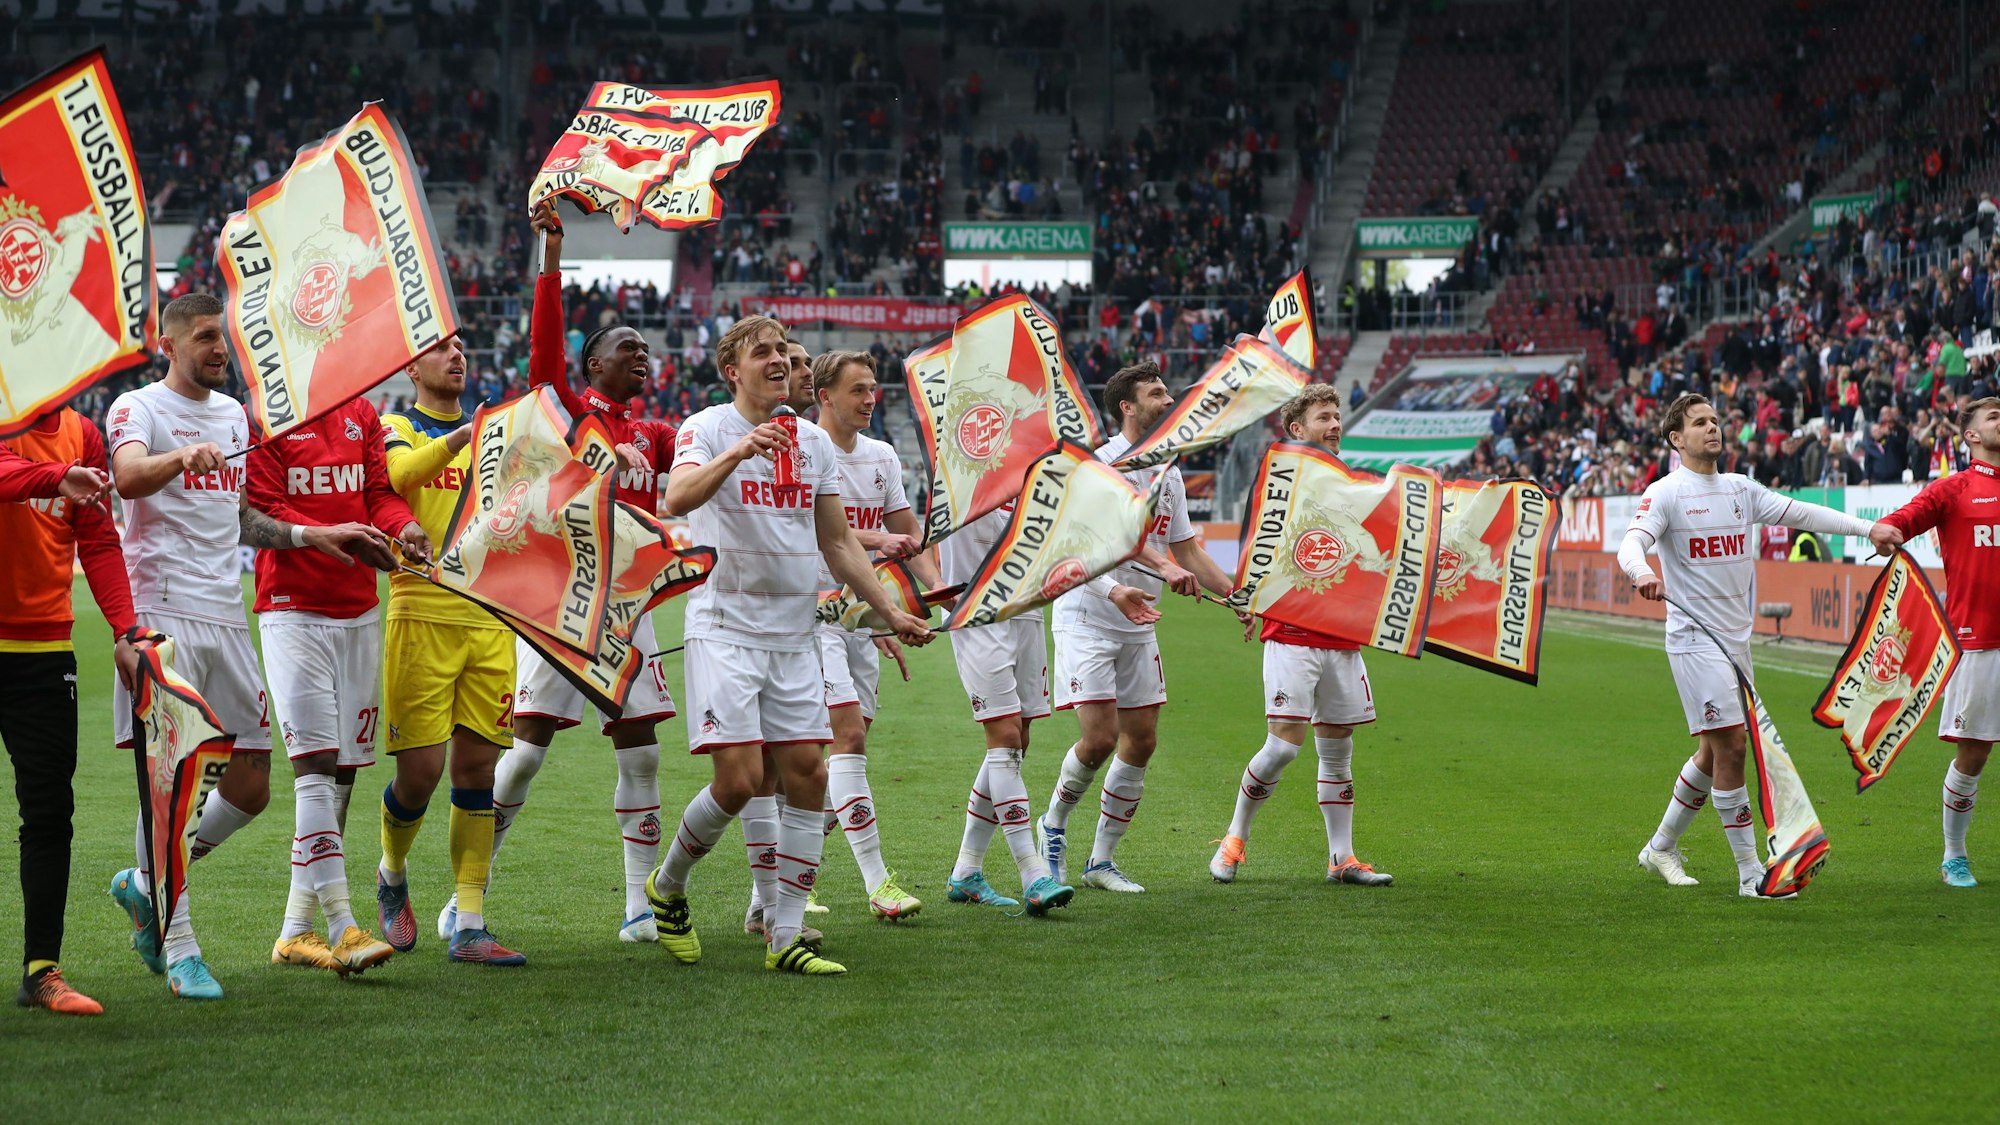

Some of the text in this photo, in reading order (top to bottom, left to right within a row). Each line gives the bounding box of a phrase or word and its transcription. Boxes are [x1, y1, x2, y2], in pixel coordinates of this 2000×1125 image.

[589, 396, 611, 412] REWE
[171, 428, 200, 437] uhlsport
[286, 432, 316, 441] uhlsport
[741, 480, 813, 508] REWE
[1972, 496, 1998, 504] uhlsport
[844, 506, 885, 529] EWE
[1811, 576, 1841, 630] web
[356, 706, 379, 744] 27
